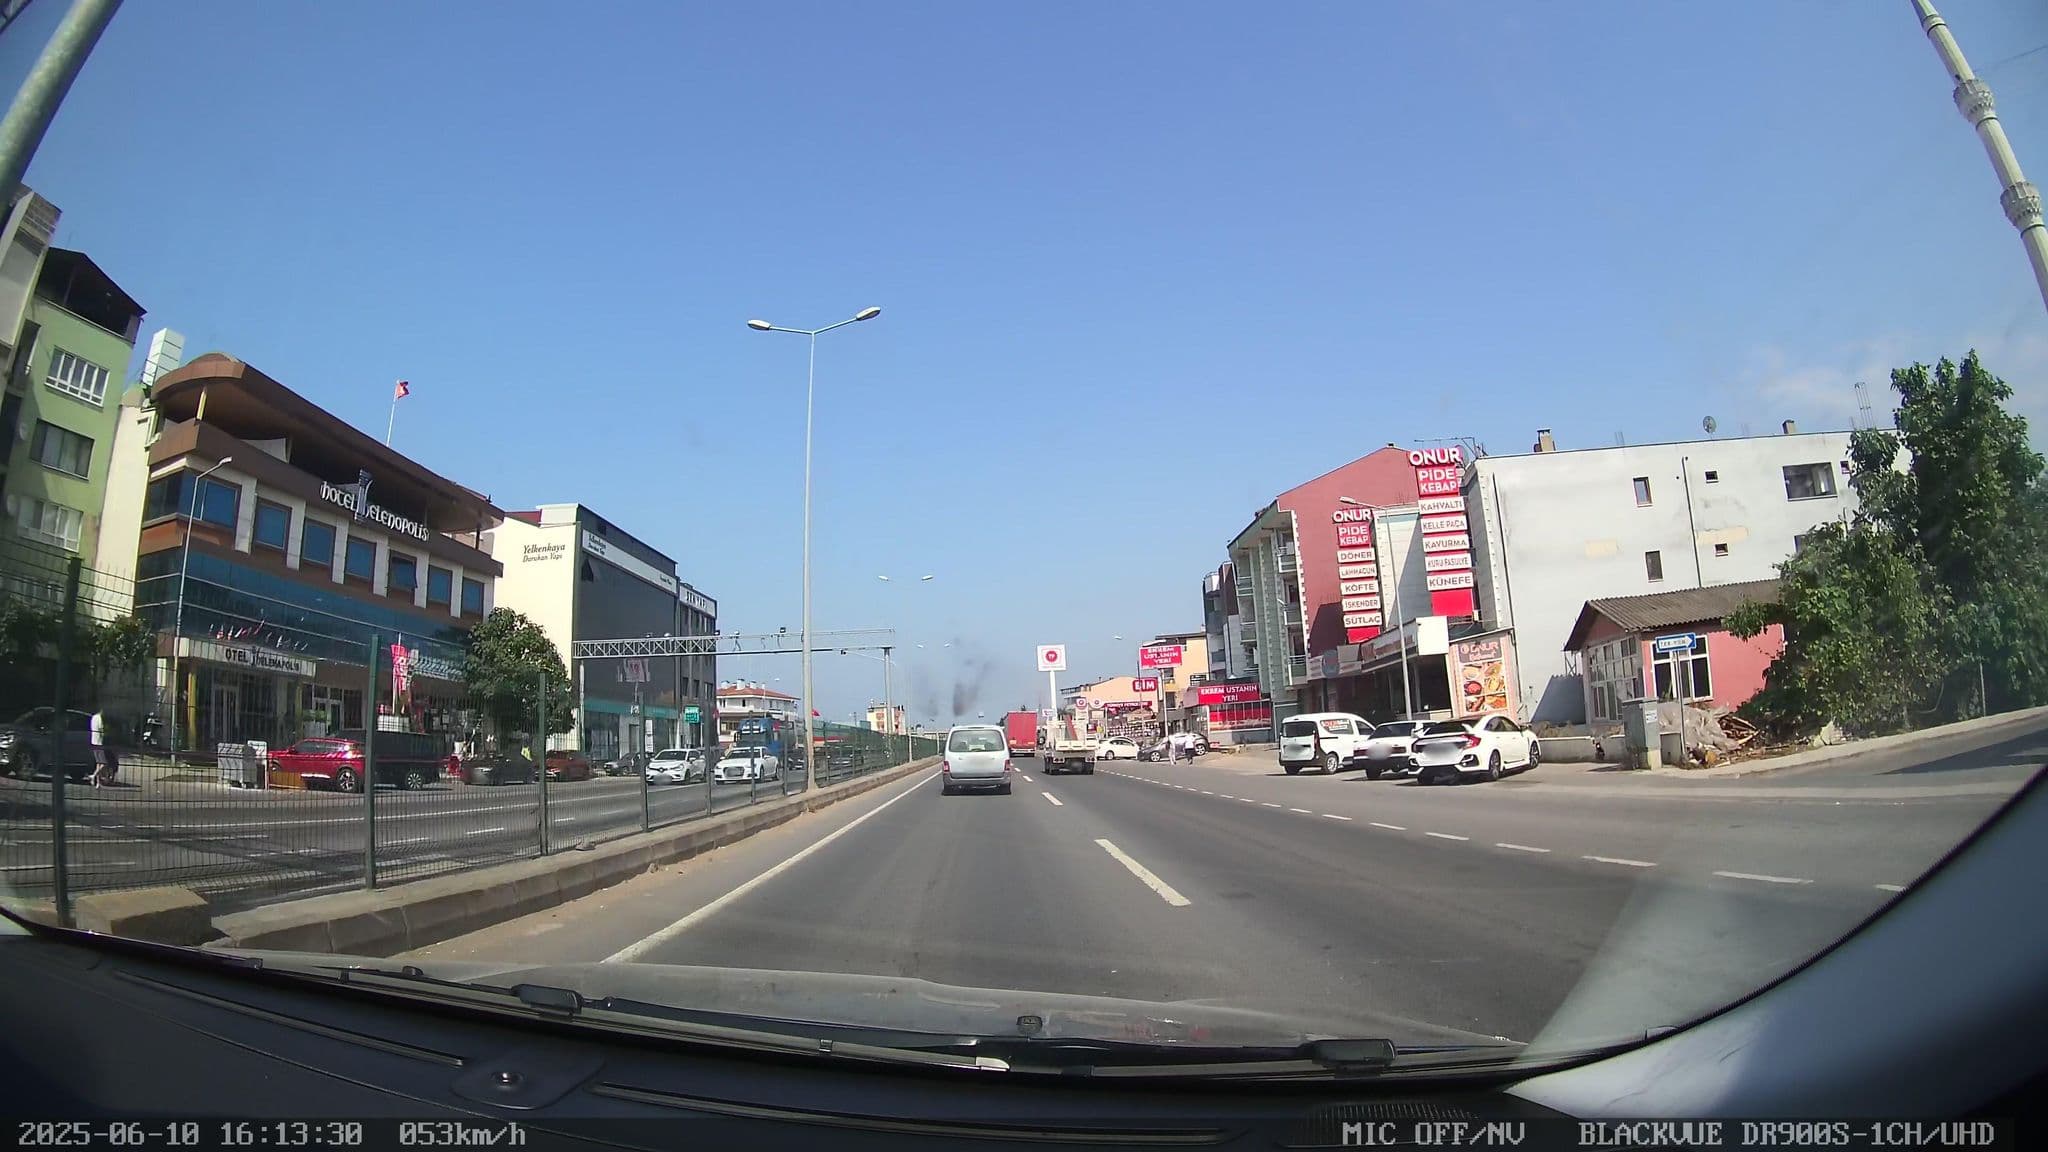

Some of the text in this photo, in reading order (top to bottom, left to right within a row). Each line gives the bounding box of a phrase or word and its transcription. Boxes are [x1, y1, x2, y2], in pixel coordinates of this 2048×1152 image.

[1410, 448, 1462, 466] ONUR
[1420, 481, 1458, 494] KEBAP
[320, 481, 356, 511] HOTEL
[1420, 500, 1463, 511] KAHVALTI
[1333, 509, 1373, 522] ONUR
[1423, 520, 1445, 530] KELLE
[1340, 536, 1369, 545] KEBAP
[1425, 539, 1467, 549] KAVURMA
[523, 543, 566, 554] Yelkenkaya
[1429, 575, 1471, 587] KÜNEFE
[225, 648, 249, 662] OTEL
